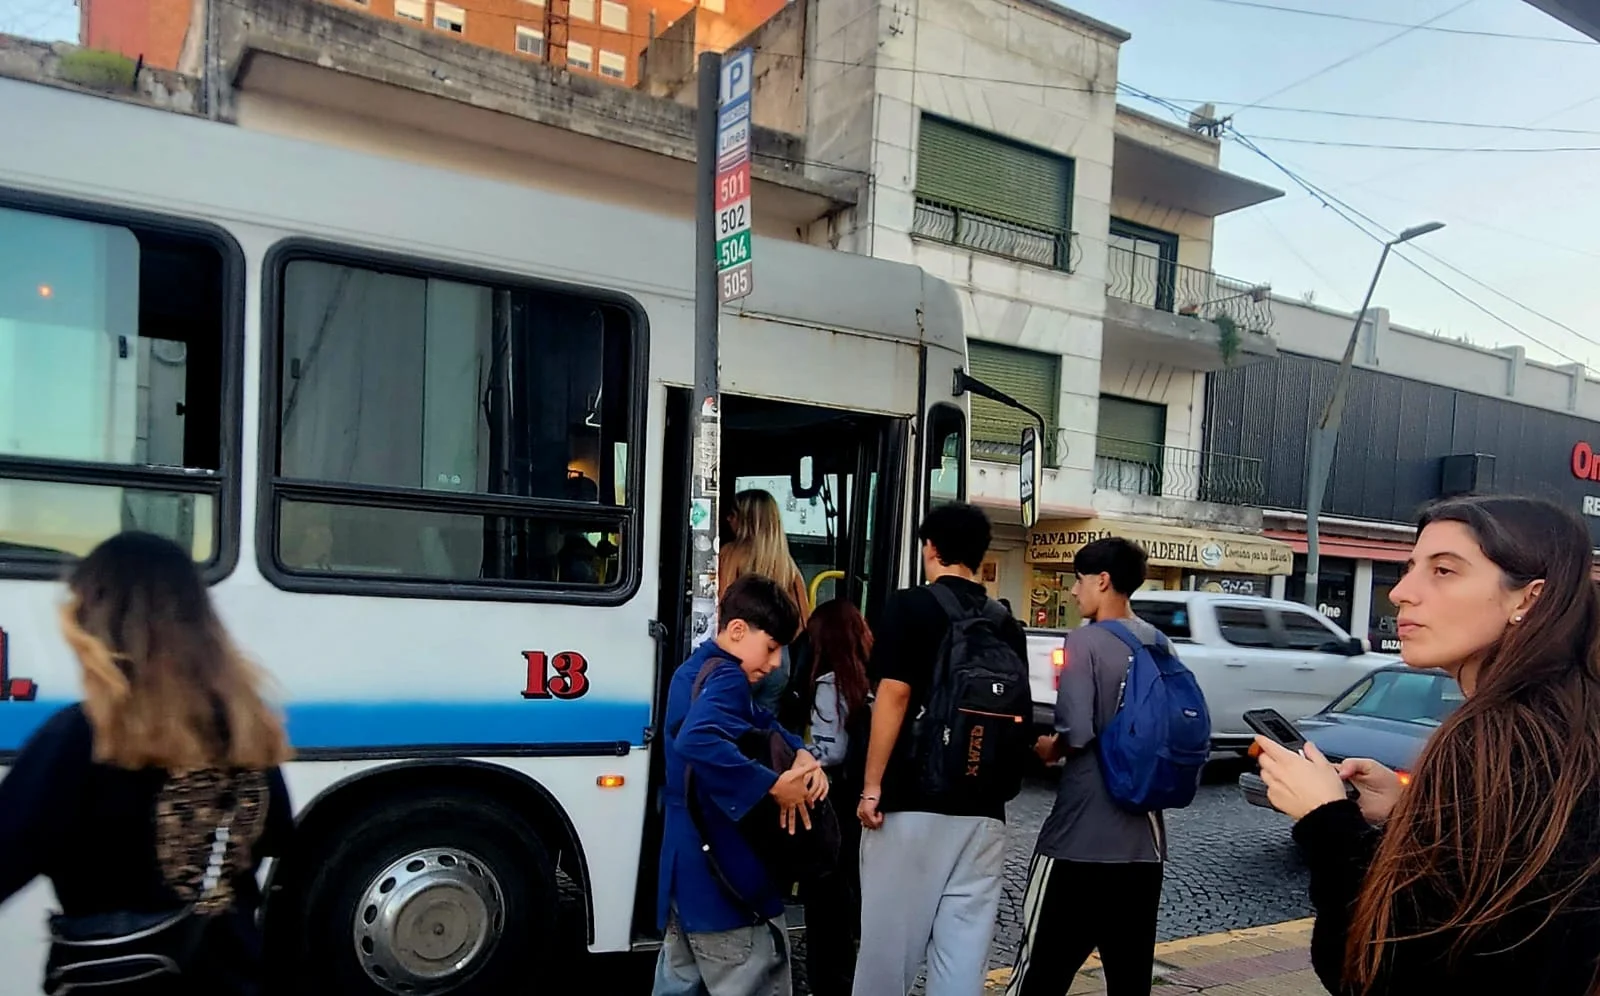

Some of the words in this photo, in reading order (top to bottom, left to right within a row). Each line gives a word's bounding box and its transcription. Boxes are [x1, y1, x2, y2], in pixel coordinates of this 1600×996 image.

[730, 62, 743, 98] P
[721, 170, 745, 202] 501
[721, 204, 745, 234] 502
[722, 235, 747, 266] 504
[724, 268, 748, 298] 505
[1319, 603, 1341, 618] One
[1381, 640, 1403, 650] BAZA
[520, 650, 590, 700] 13
